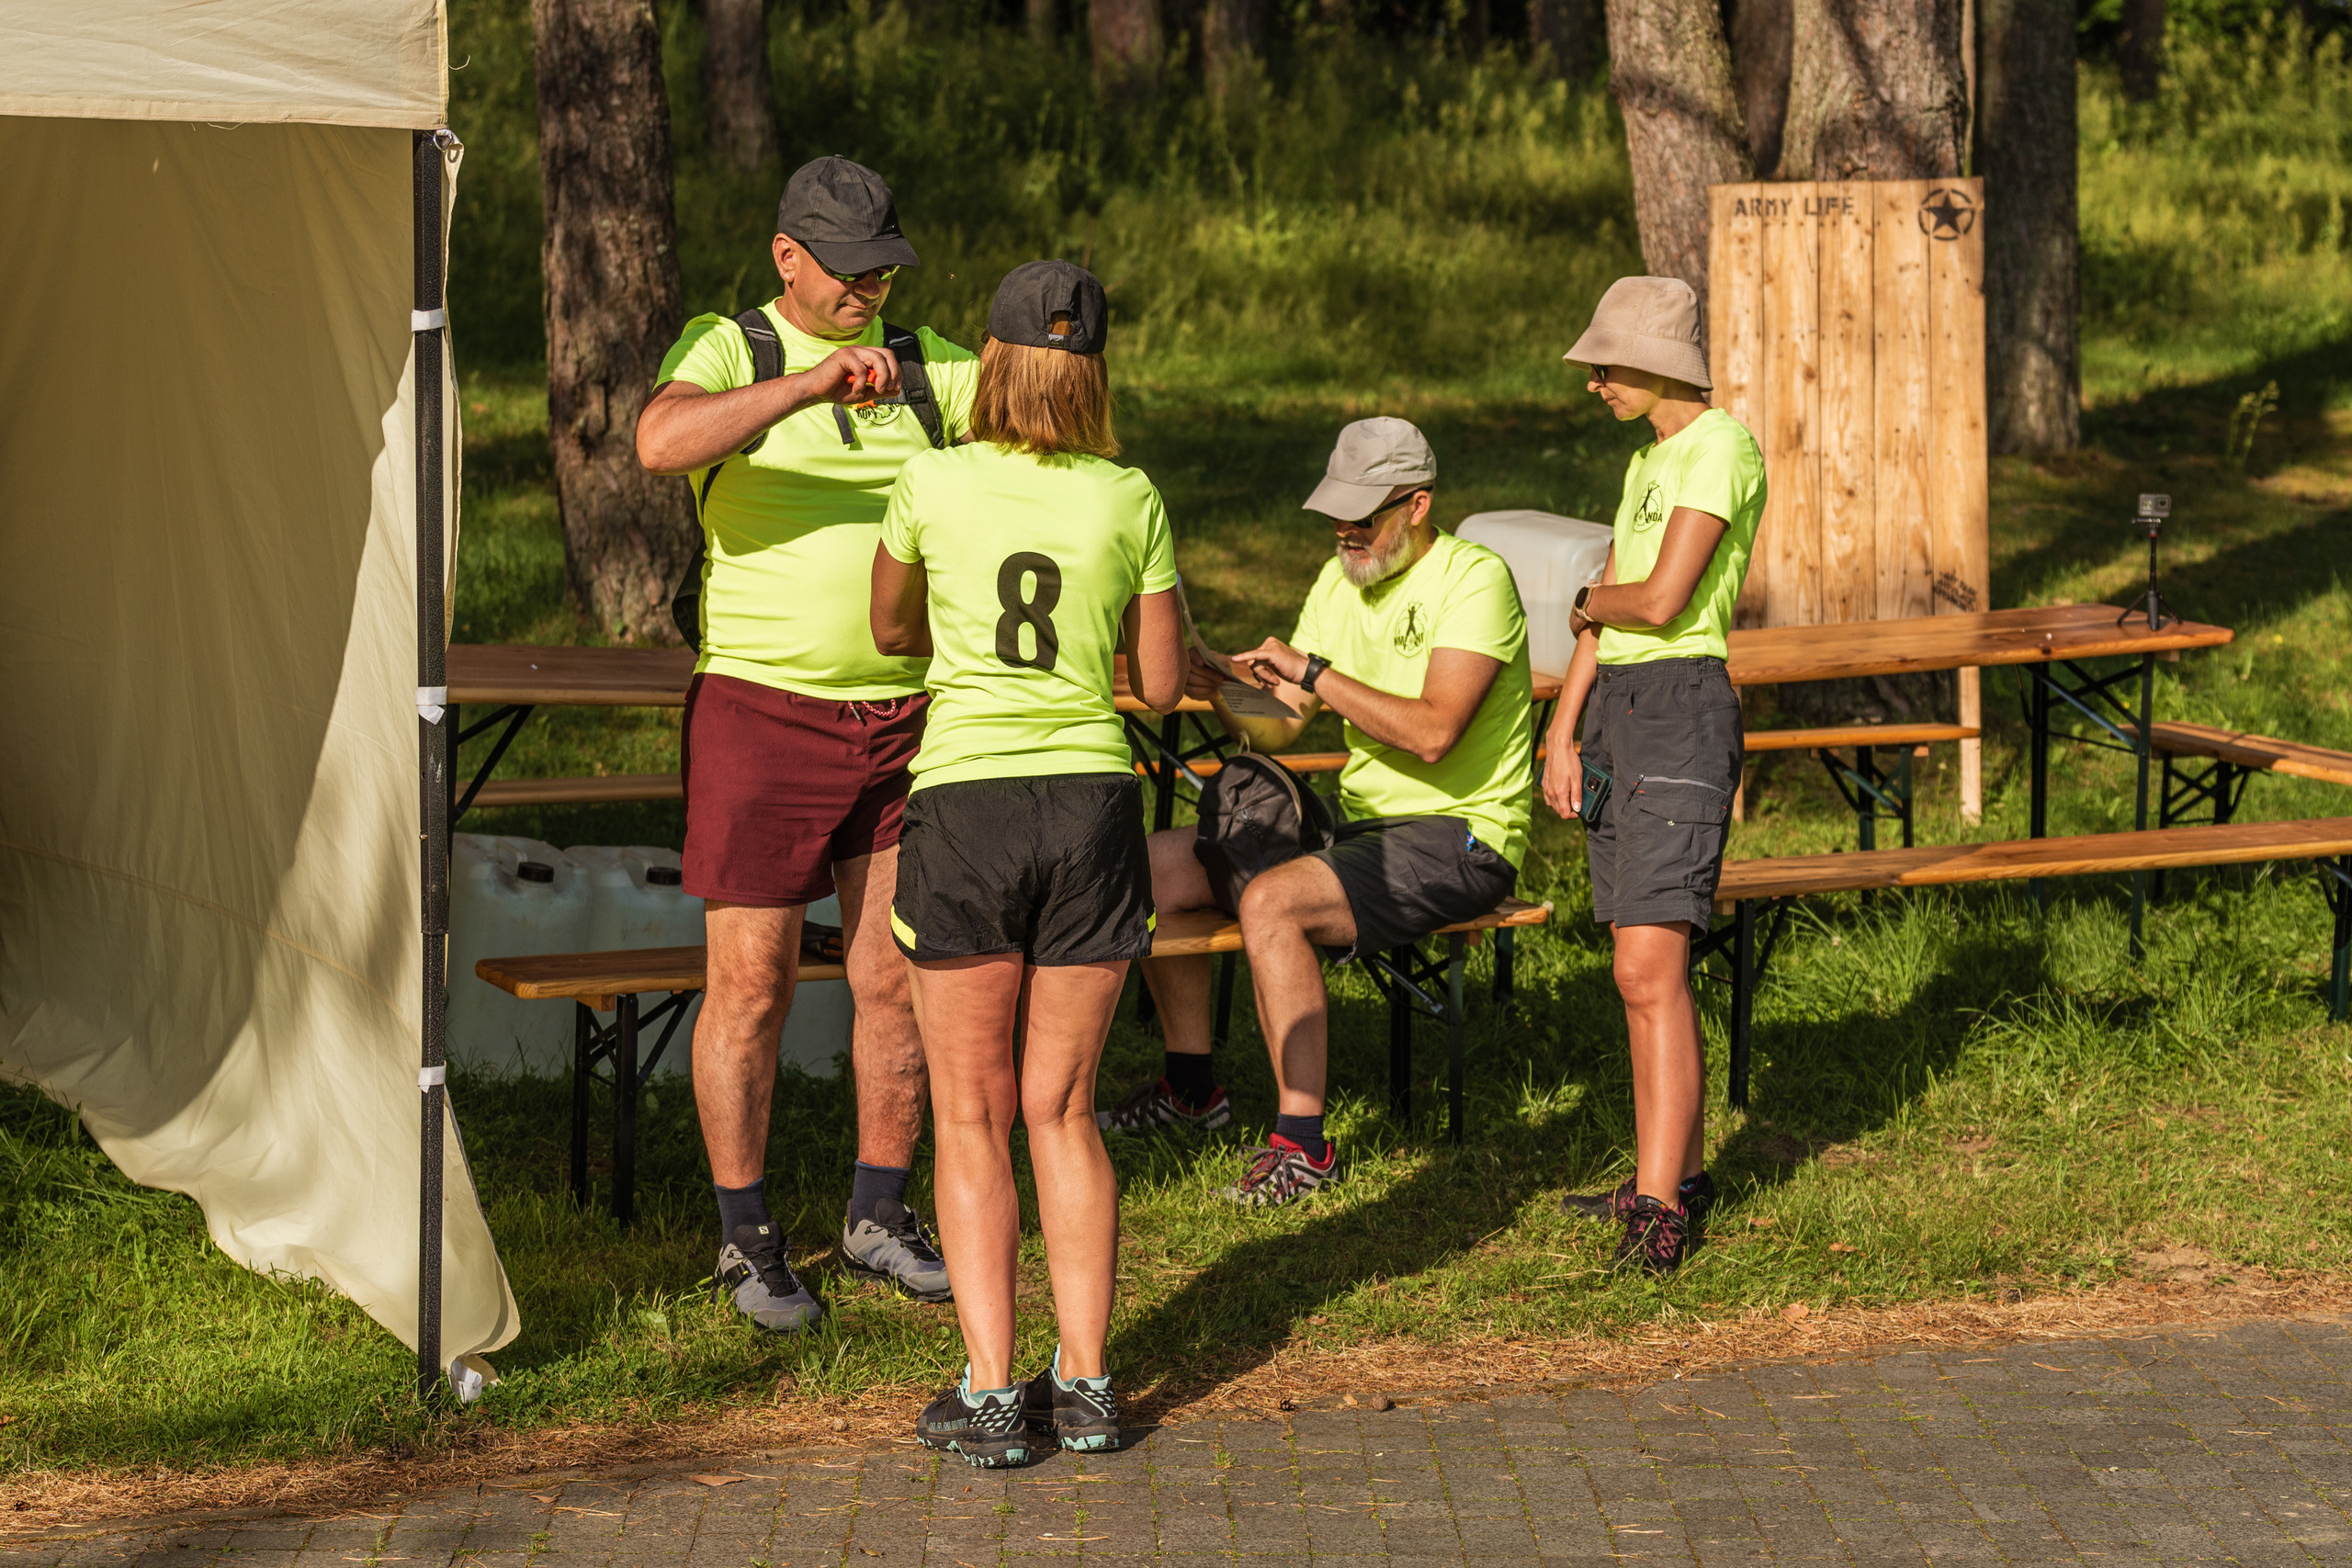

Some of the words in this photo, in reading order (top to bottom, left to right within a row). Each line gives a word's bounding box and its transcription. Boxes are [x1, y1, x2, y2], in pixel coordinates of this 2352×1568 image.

[1735, 197, 1792, 217] ARMY
[1804, 196, 1855, 217] LIFE
[995, 551, 1062, 671] 8
[929, 1418, 968, 1433] MAMMUT
